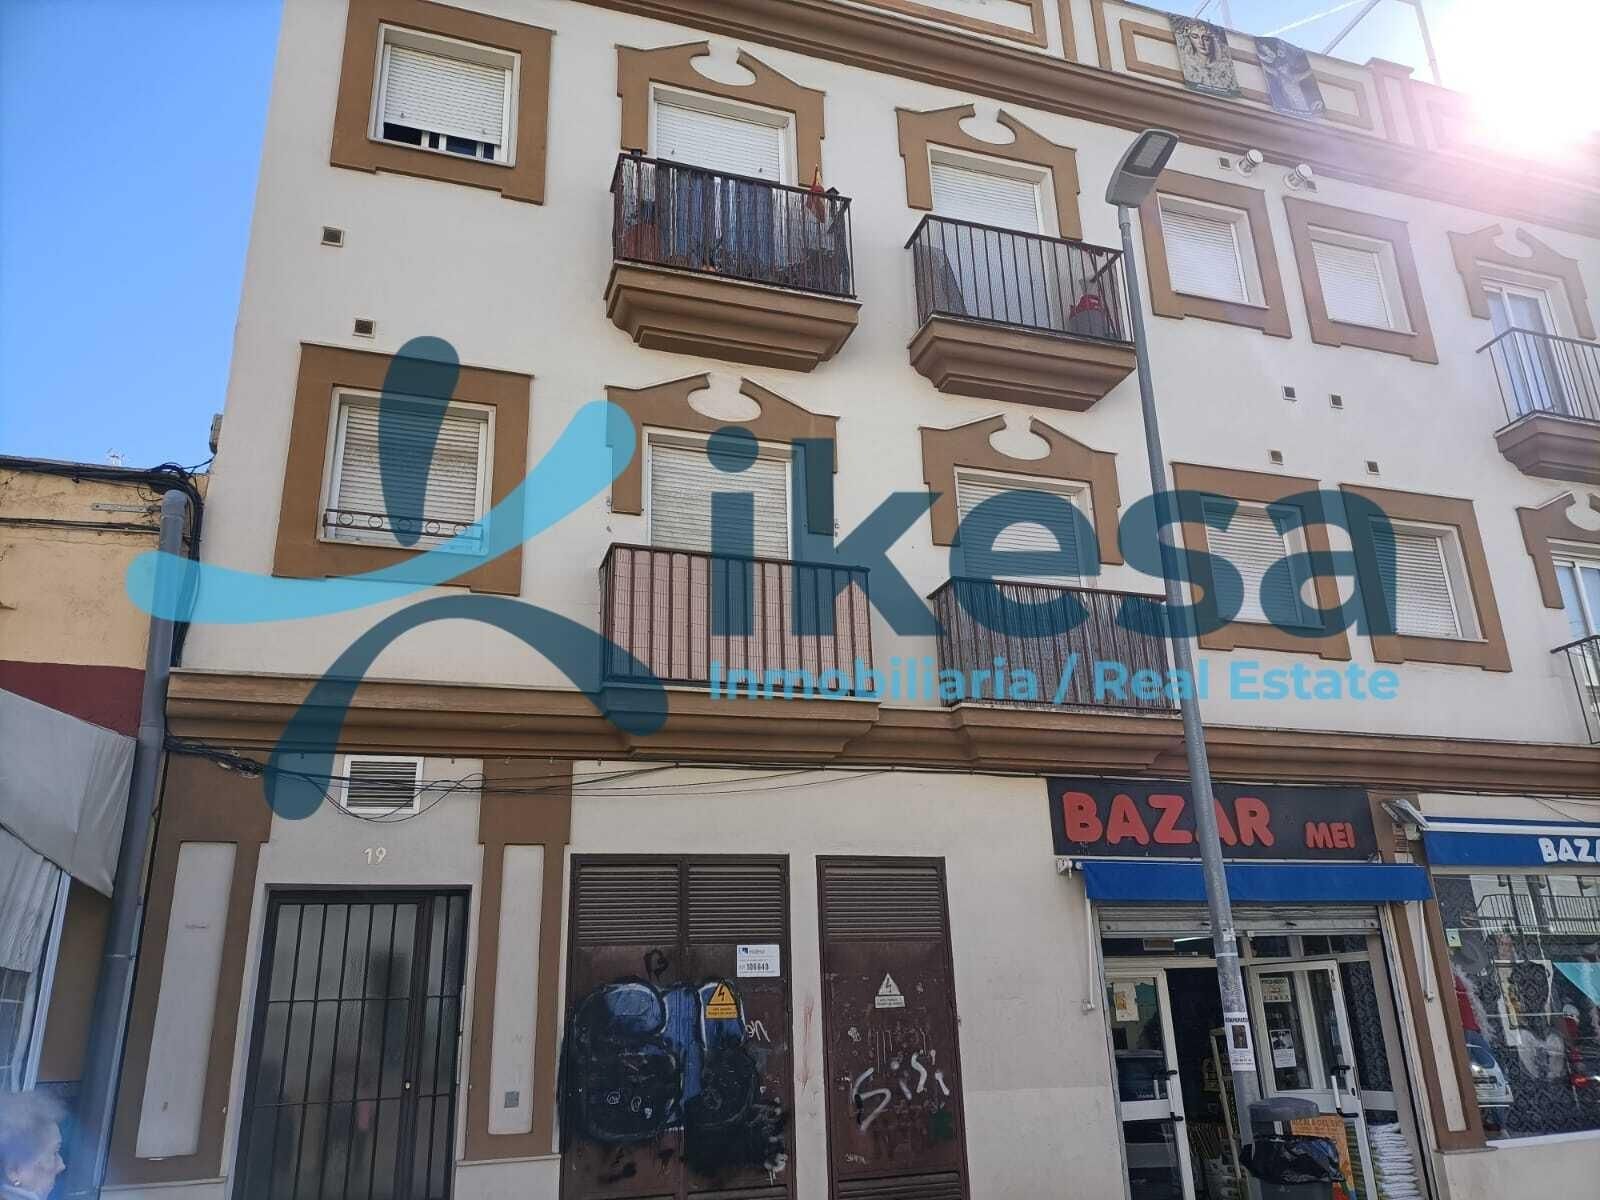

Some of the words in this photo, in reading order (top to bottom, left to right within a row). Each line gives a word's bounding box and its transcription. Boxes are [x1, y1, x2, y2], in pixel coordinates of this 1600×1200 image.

[1305, 821, 1356, 849] MEI
[364, 847, 386, 865] 19
[1538, 837, 1600, 863] BAZ
